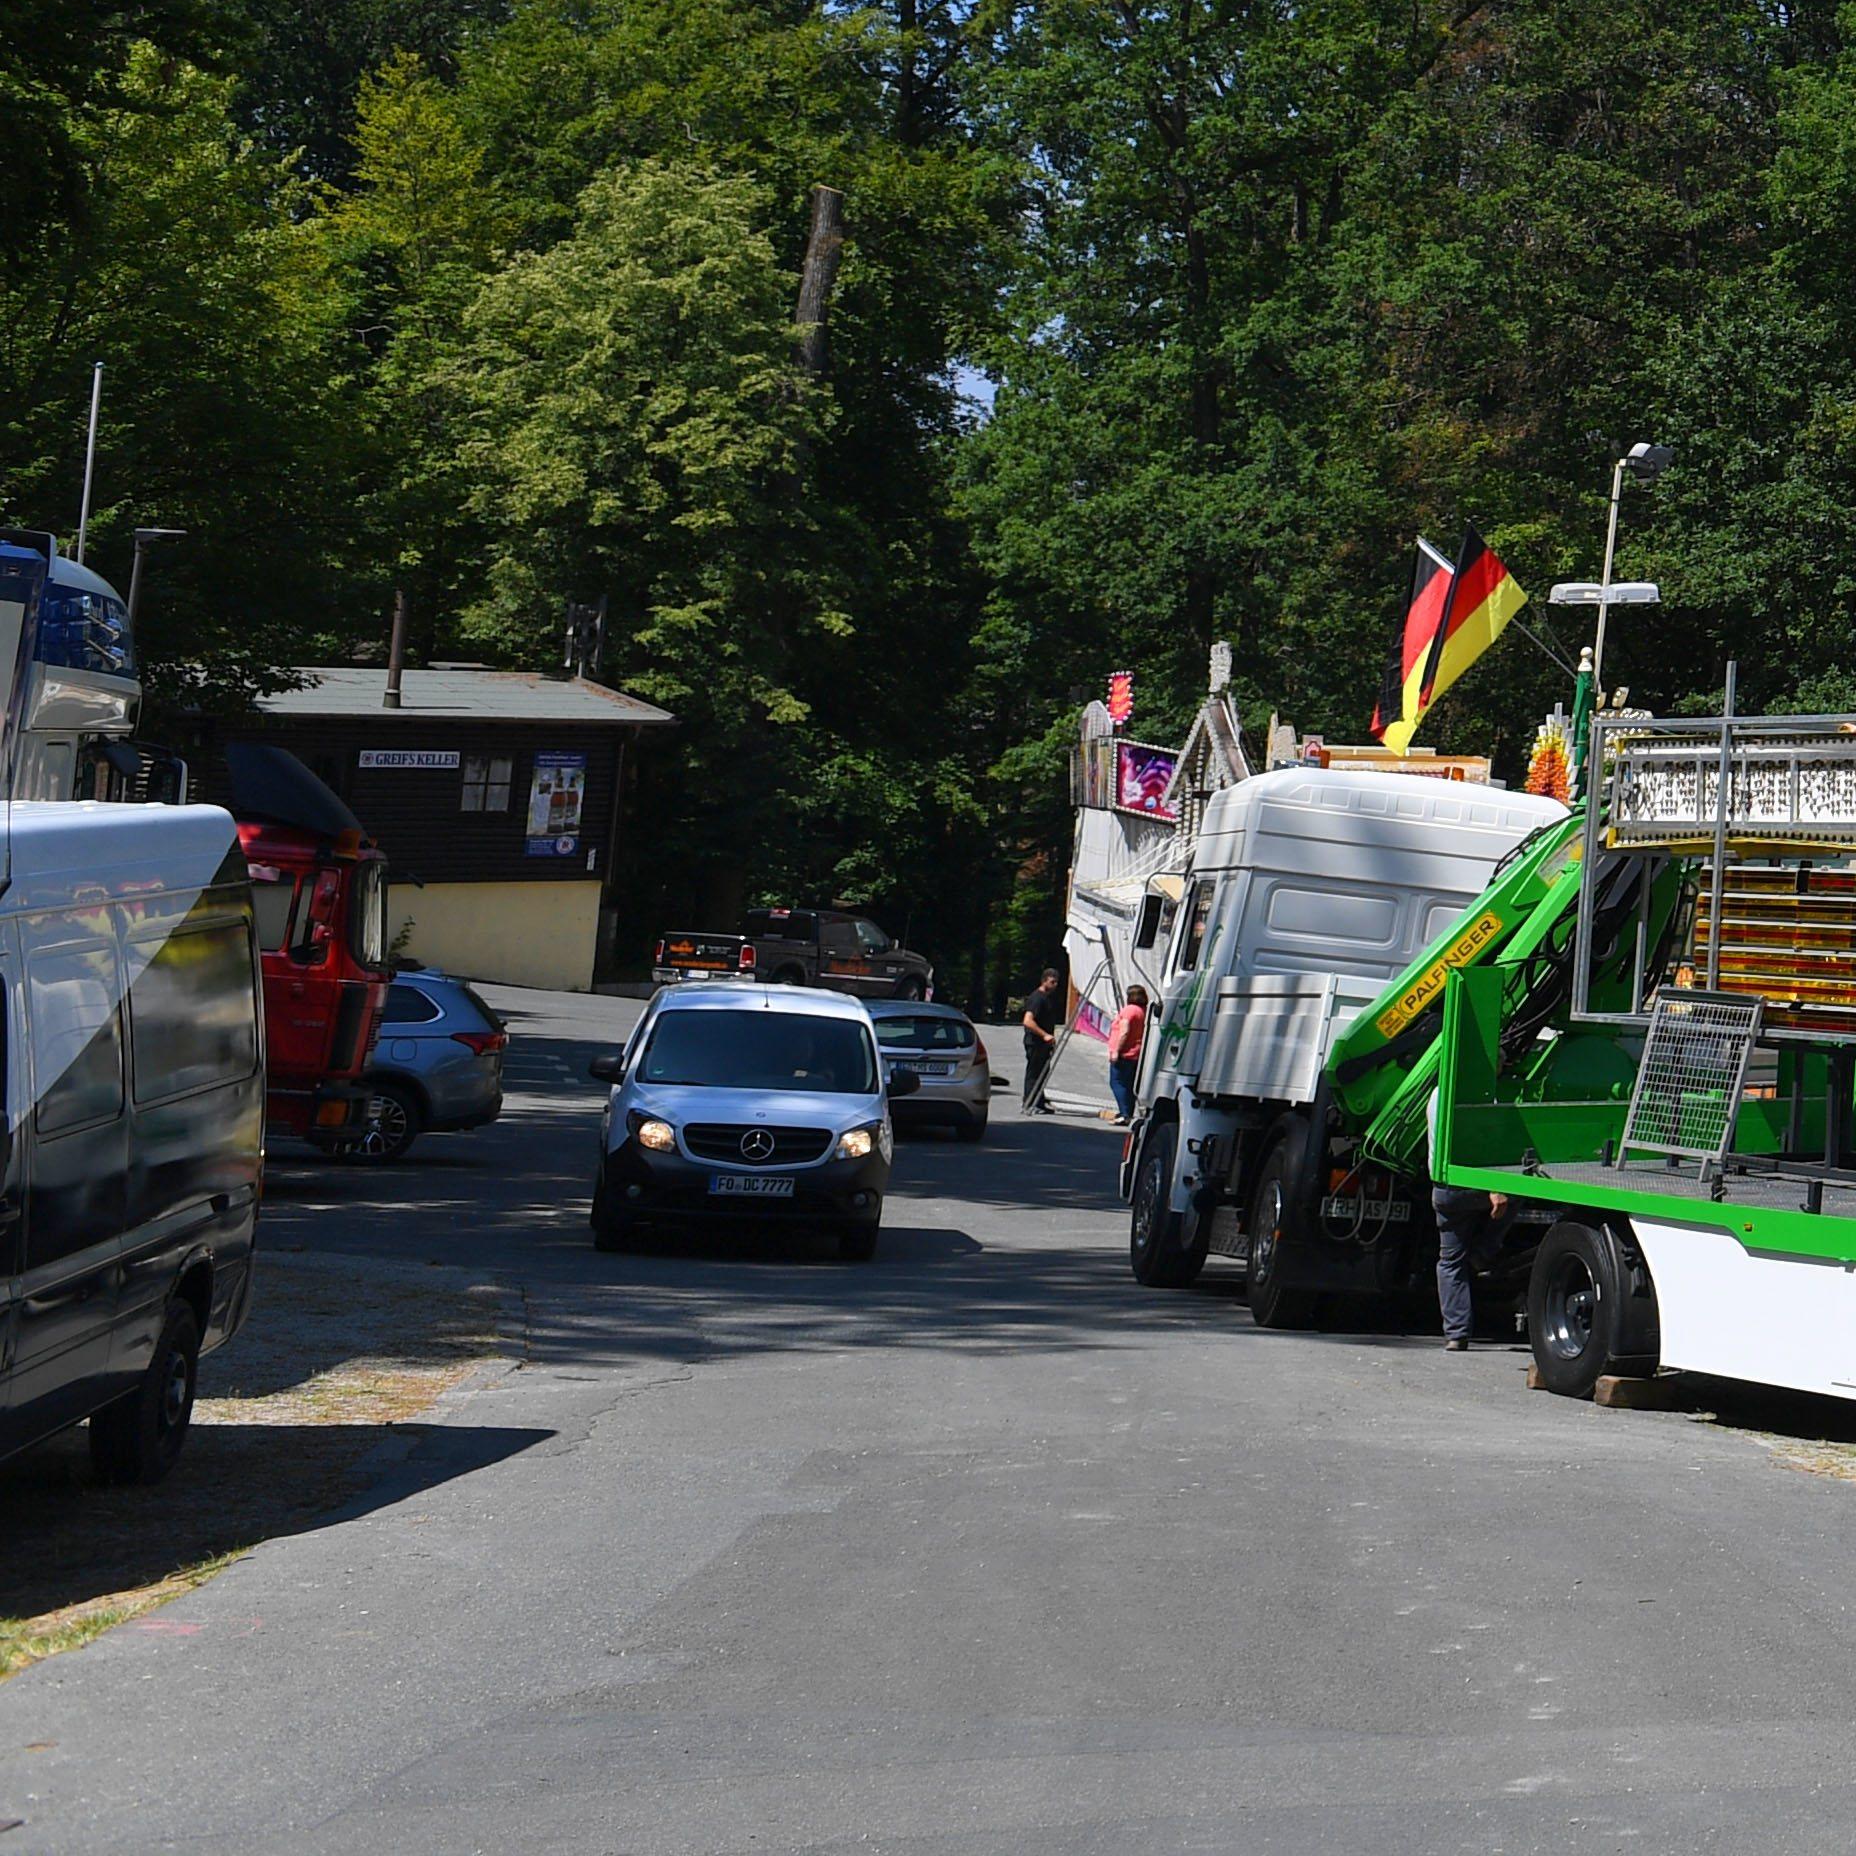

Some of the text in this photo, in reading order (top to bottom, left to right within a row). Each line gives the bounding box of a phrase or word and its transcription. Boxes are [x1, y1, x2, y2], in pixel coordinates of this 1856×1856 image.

[375, 753, 458, 765] GREIFS KELLER
[1404, 919, 1496, 1011] PALFINGER
[718, 1177, 735, 1190] FO
[762, 1179, 792, 1192] 7777
